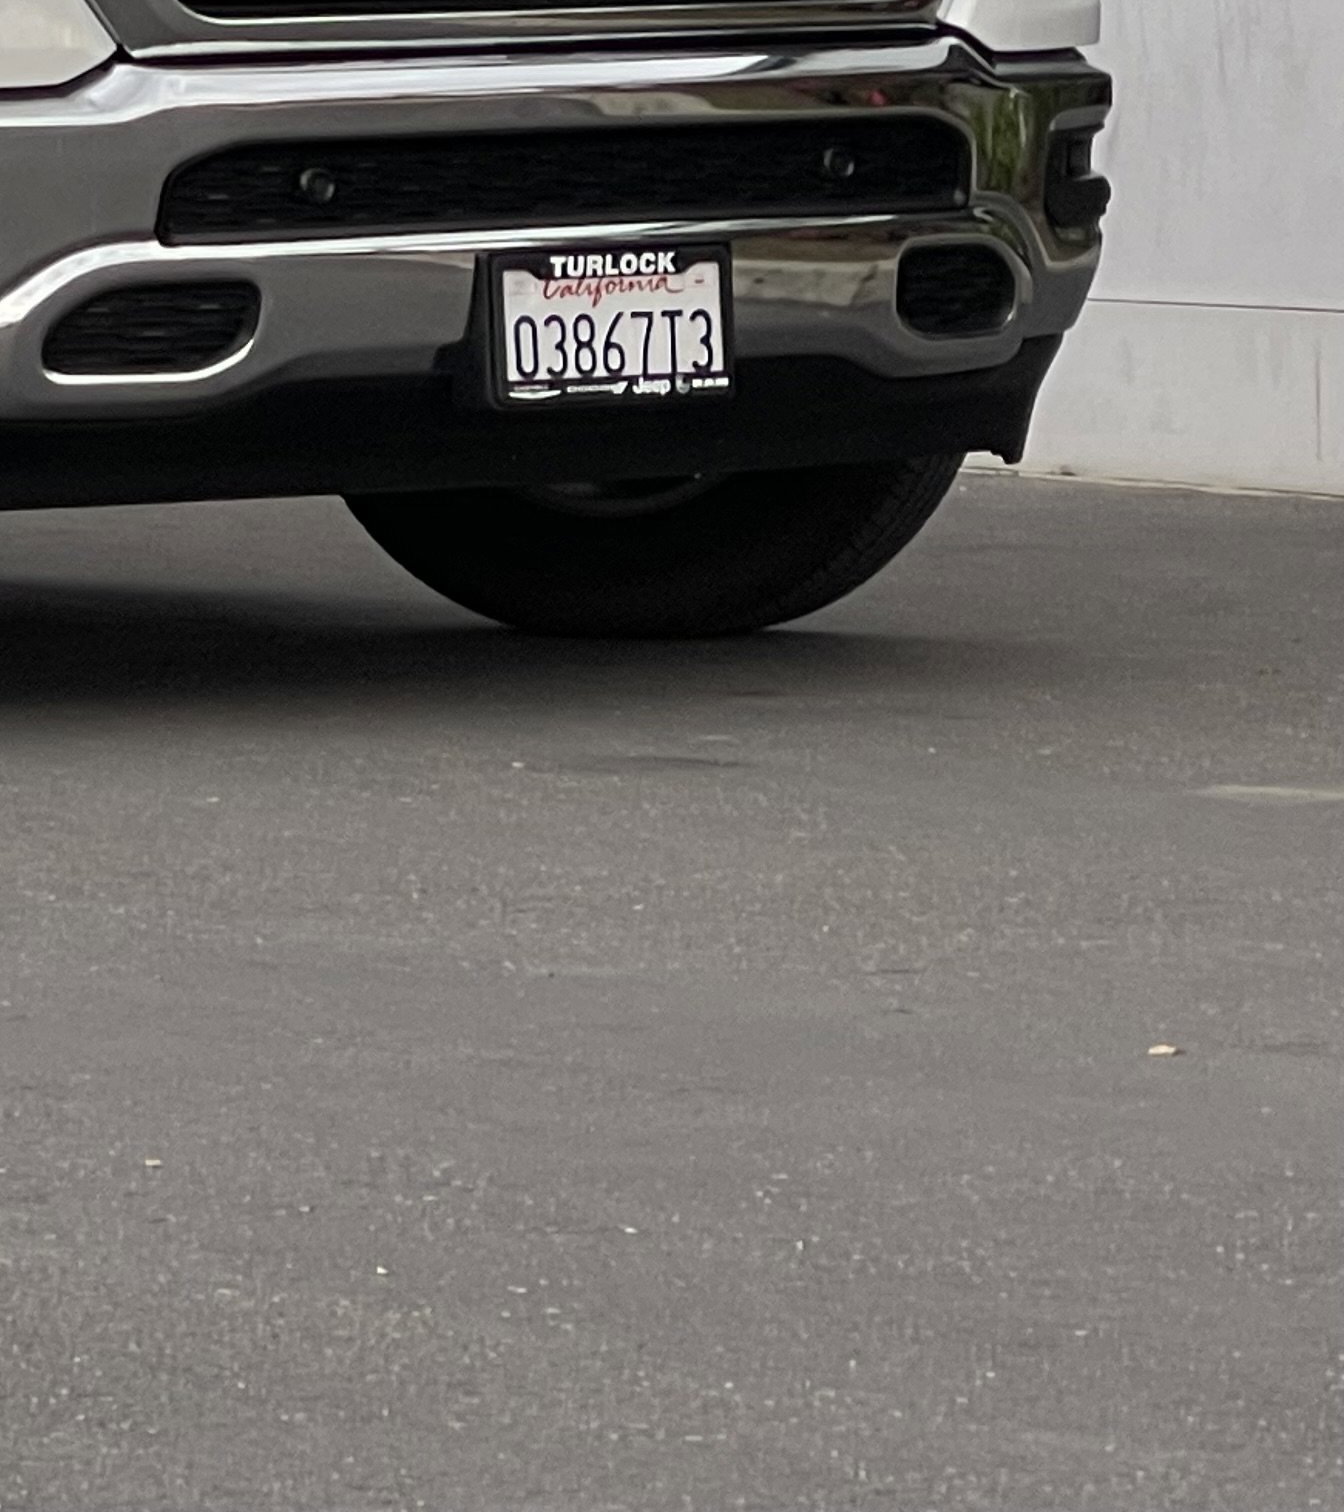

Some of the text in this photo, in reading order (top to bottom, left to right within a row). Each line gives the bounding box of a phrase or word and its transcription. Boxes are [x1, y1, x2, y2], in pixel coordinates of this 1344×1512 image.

[550, 251, 675, 277] TURLOCK
[543, 276, 683, 306] California
[513, 309, 713, 377] 03867T3
